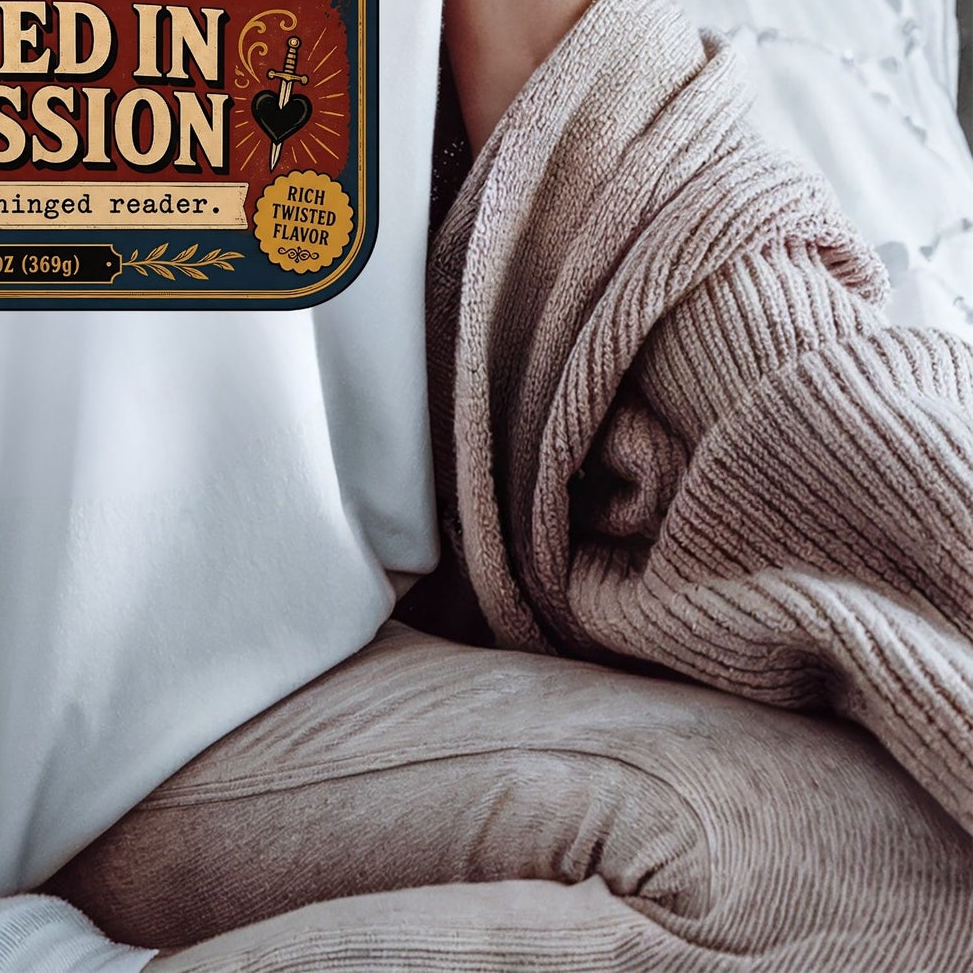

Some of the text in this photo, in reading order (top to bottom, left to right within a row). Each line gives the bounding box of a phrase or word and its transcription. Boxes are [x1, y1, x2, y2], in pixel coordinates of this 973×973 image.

[133, 3, 227, 84] IN
[109, 194, 220, 215] reader.
[287, 185, 326, 205] RICH
[272, 203, 336, 227] TWISTED
[272, 223, 330, 246] FLAVOR
[21, 254, 80, 277] (369g)
